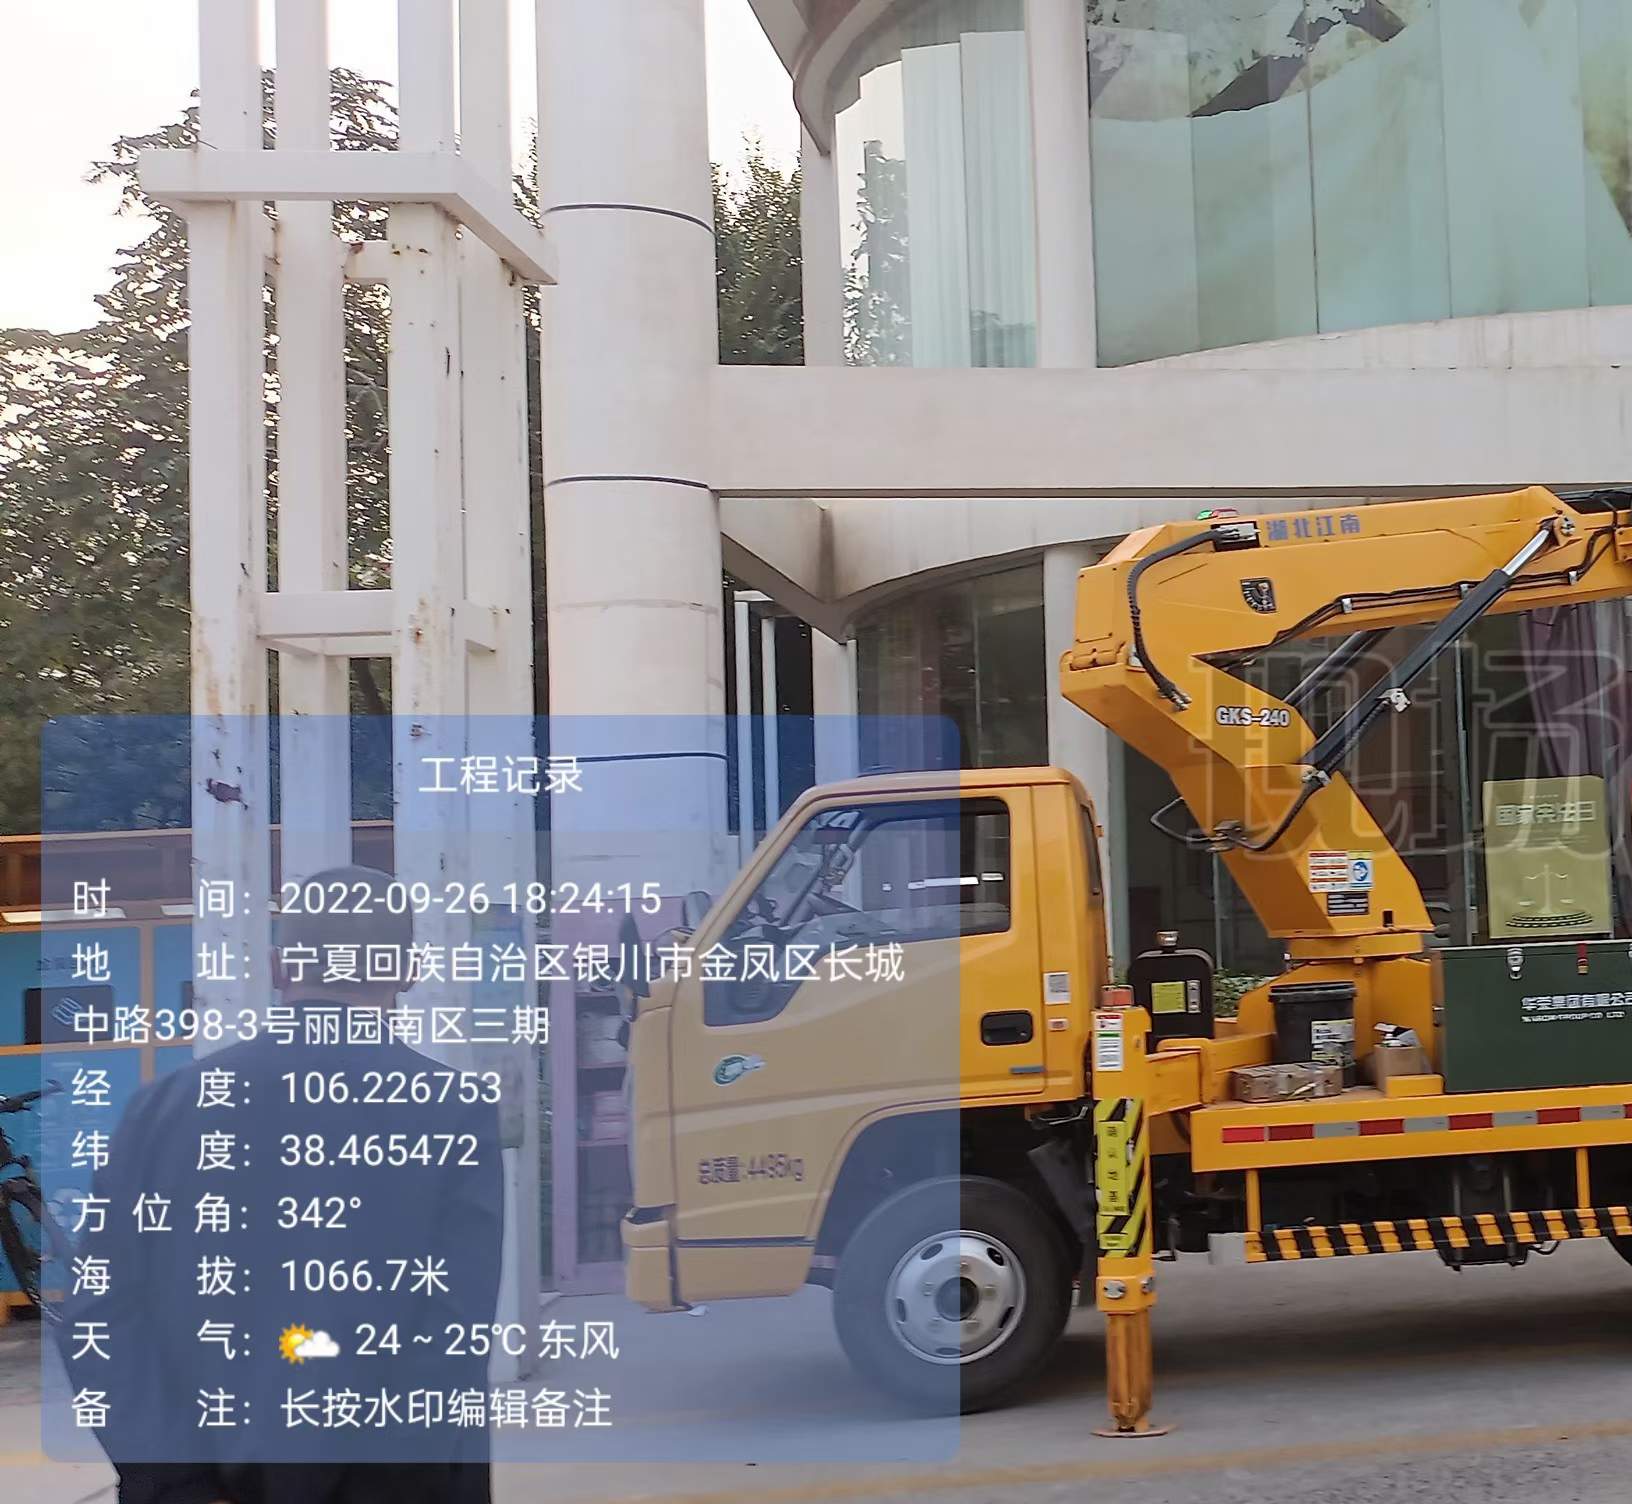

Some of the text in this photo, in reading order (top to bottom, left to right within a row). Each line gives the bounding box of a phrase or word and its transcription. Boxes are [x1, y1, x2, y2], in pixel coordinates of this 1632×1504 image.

[1266, 514, 1361, 541] 湖北江南
[1215, 705, 1291, 728] GKS-240
